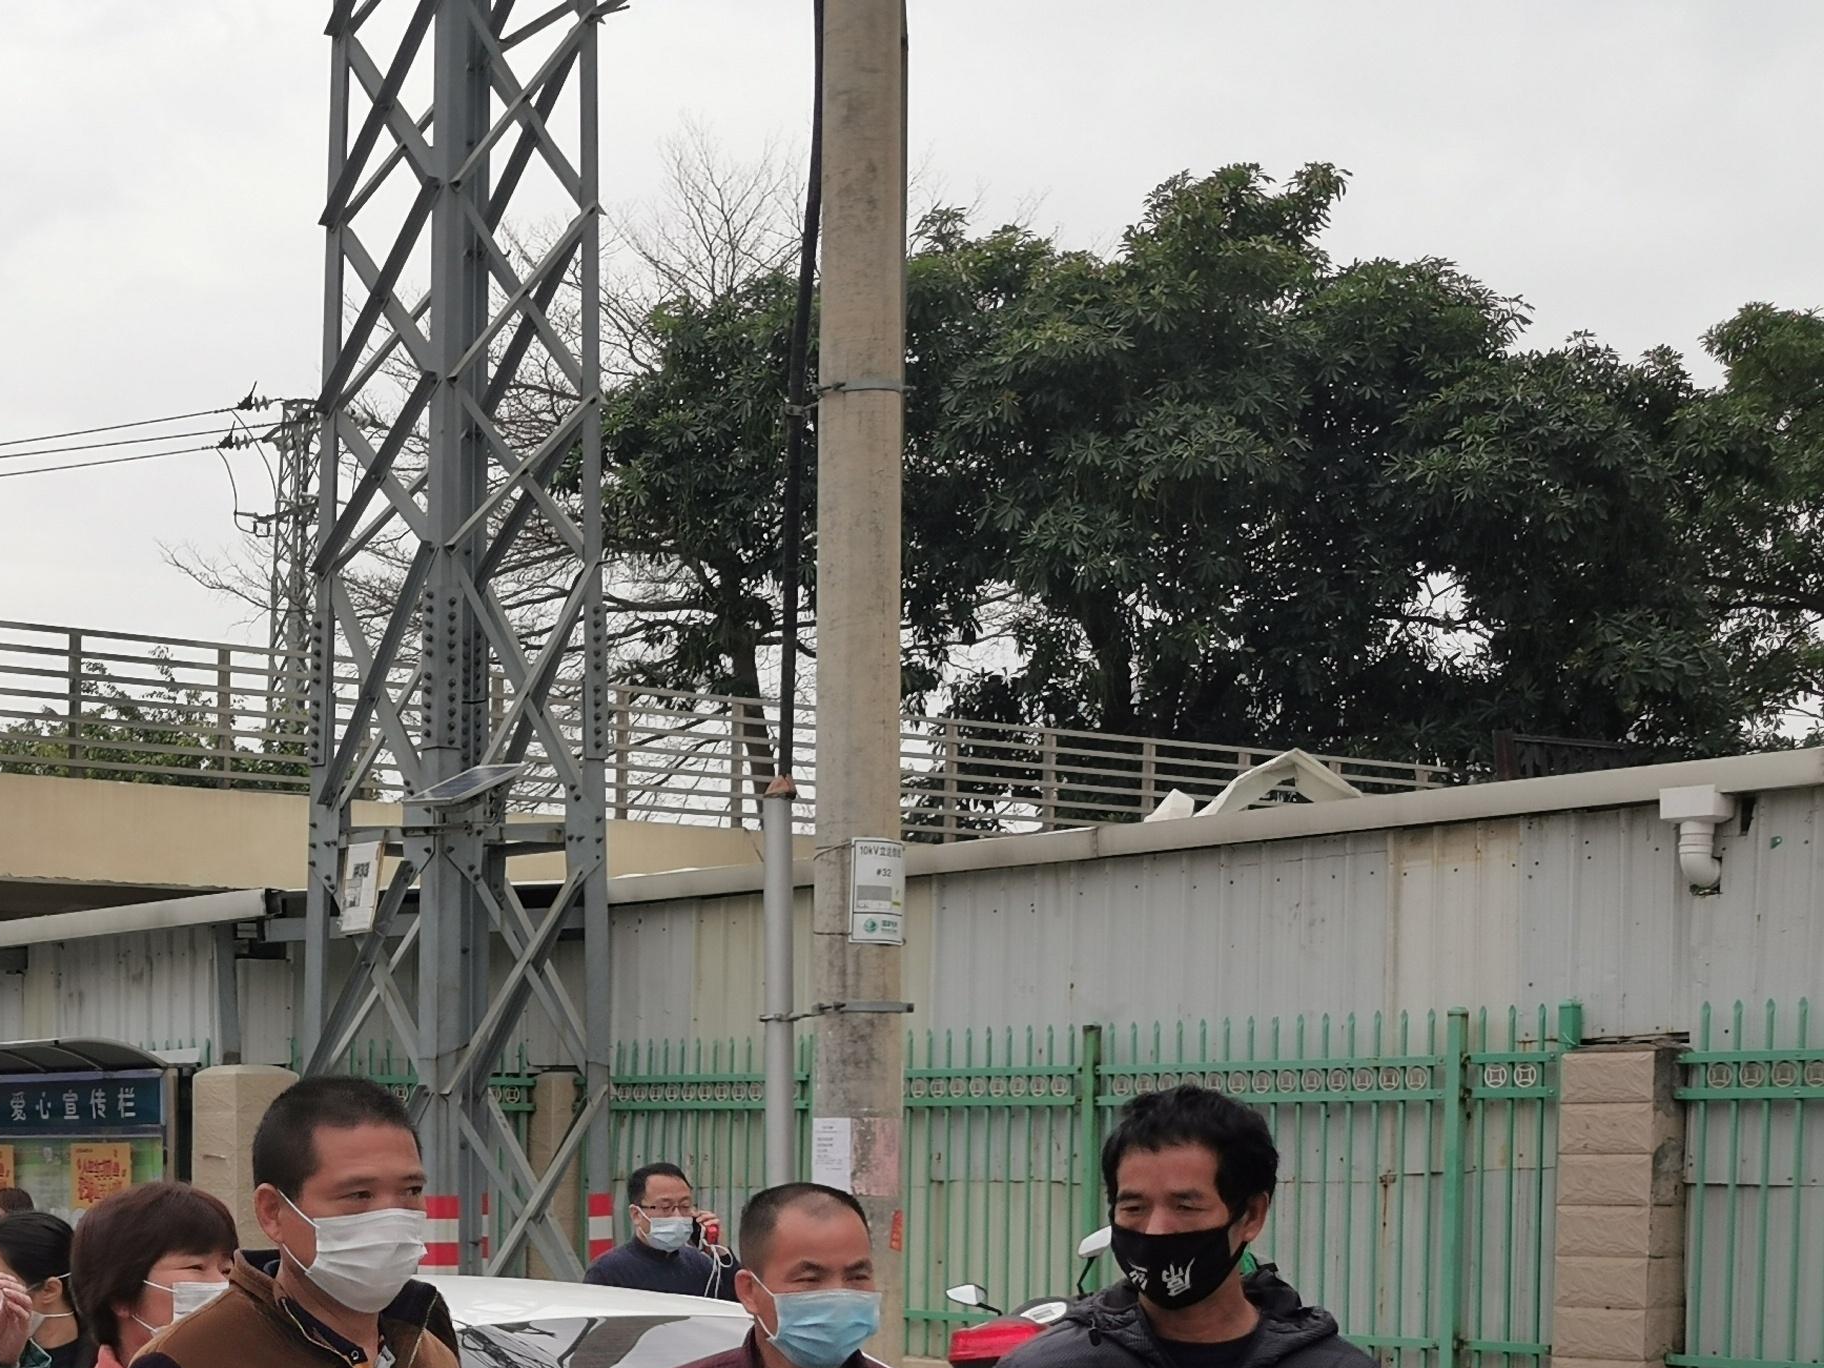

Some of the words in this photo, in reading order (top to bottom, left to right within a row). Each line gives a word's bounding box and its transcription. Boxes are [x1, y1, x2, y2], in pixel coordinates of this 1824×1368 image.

[10, 1087, 137, 1121] 爱心宣传栏
